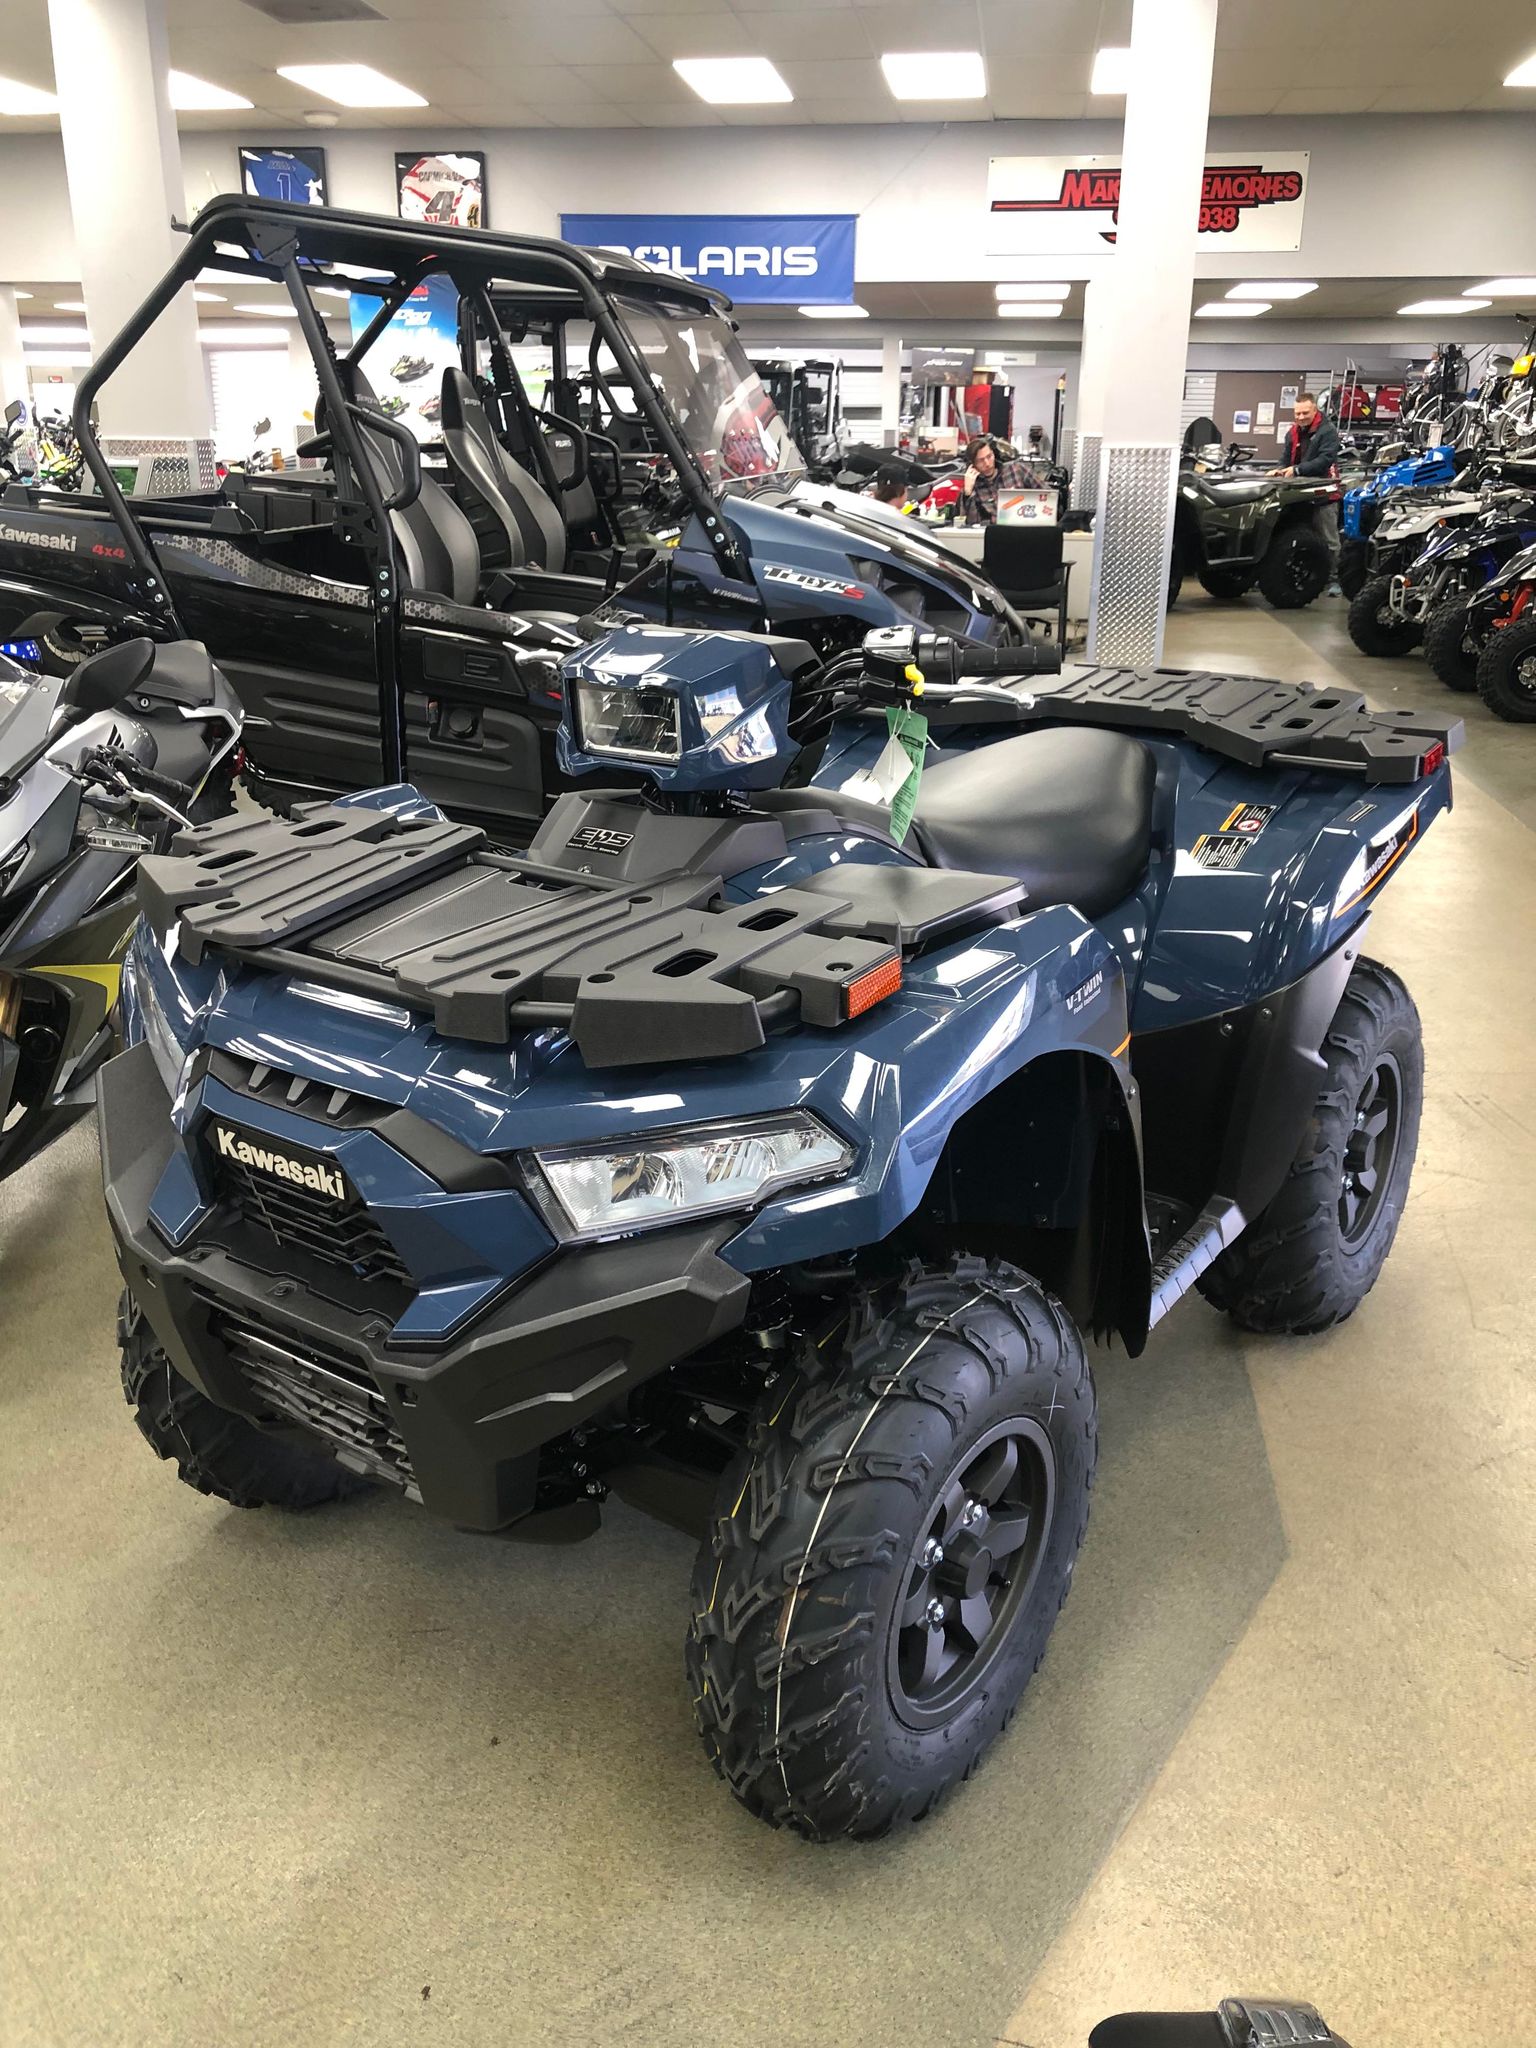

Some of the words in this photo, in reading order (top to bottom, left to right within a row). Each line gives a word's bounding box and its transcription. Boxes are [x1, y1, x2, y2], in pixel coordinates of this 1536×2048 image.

[1200, 174, 1300, 201] EMORIES
[425, 190, 457, 221] 4
[1199, 206, 1237, 230] 938
[91, 544, 126, 559] 4x4
[573, 826, 635, 847] EPS
[1066, 970, 1103, 1010] V-TWIN
[216, 1126, 346, 1201] Kawasaki
